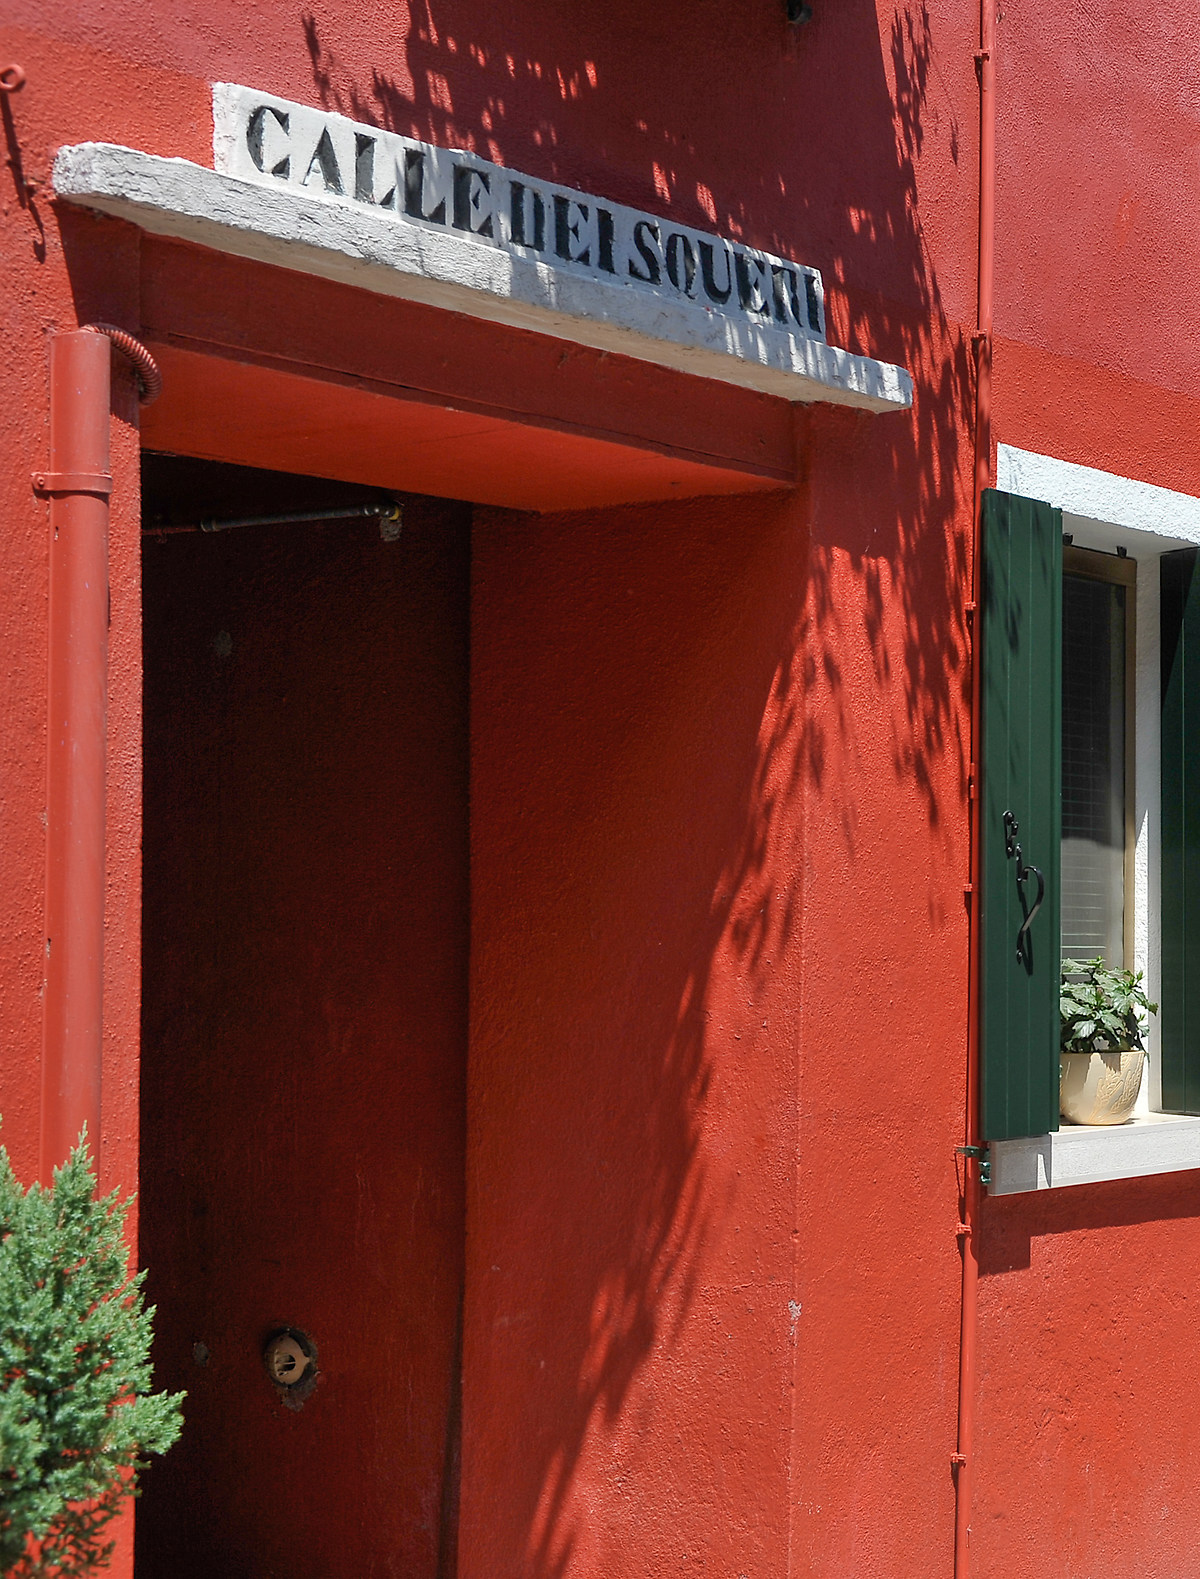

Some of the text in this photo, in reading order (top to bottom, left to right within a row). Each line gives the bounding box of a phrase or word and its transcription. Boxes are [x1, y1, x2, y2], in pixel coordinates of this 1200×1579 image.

[246, 105, 822, 334] CALLE DEI SQUERI
